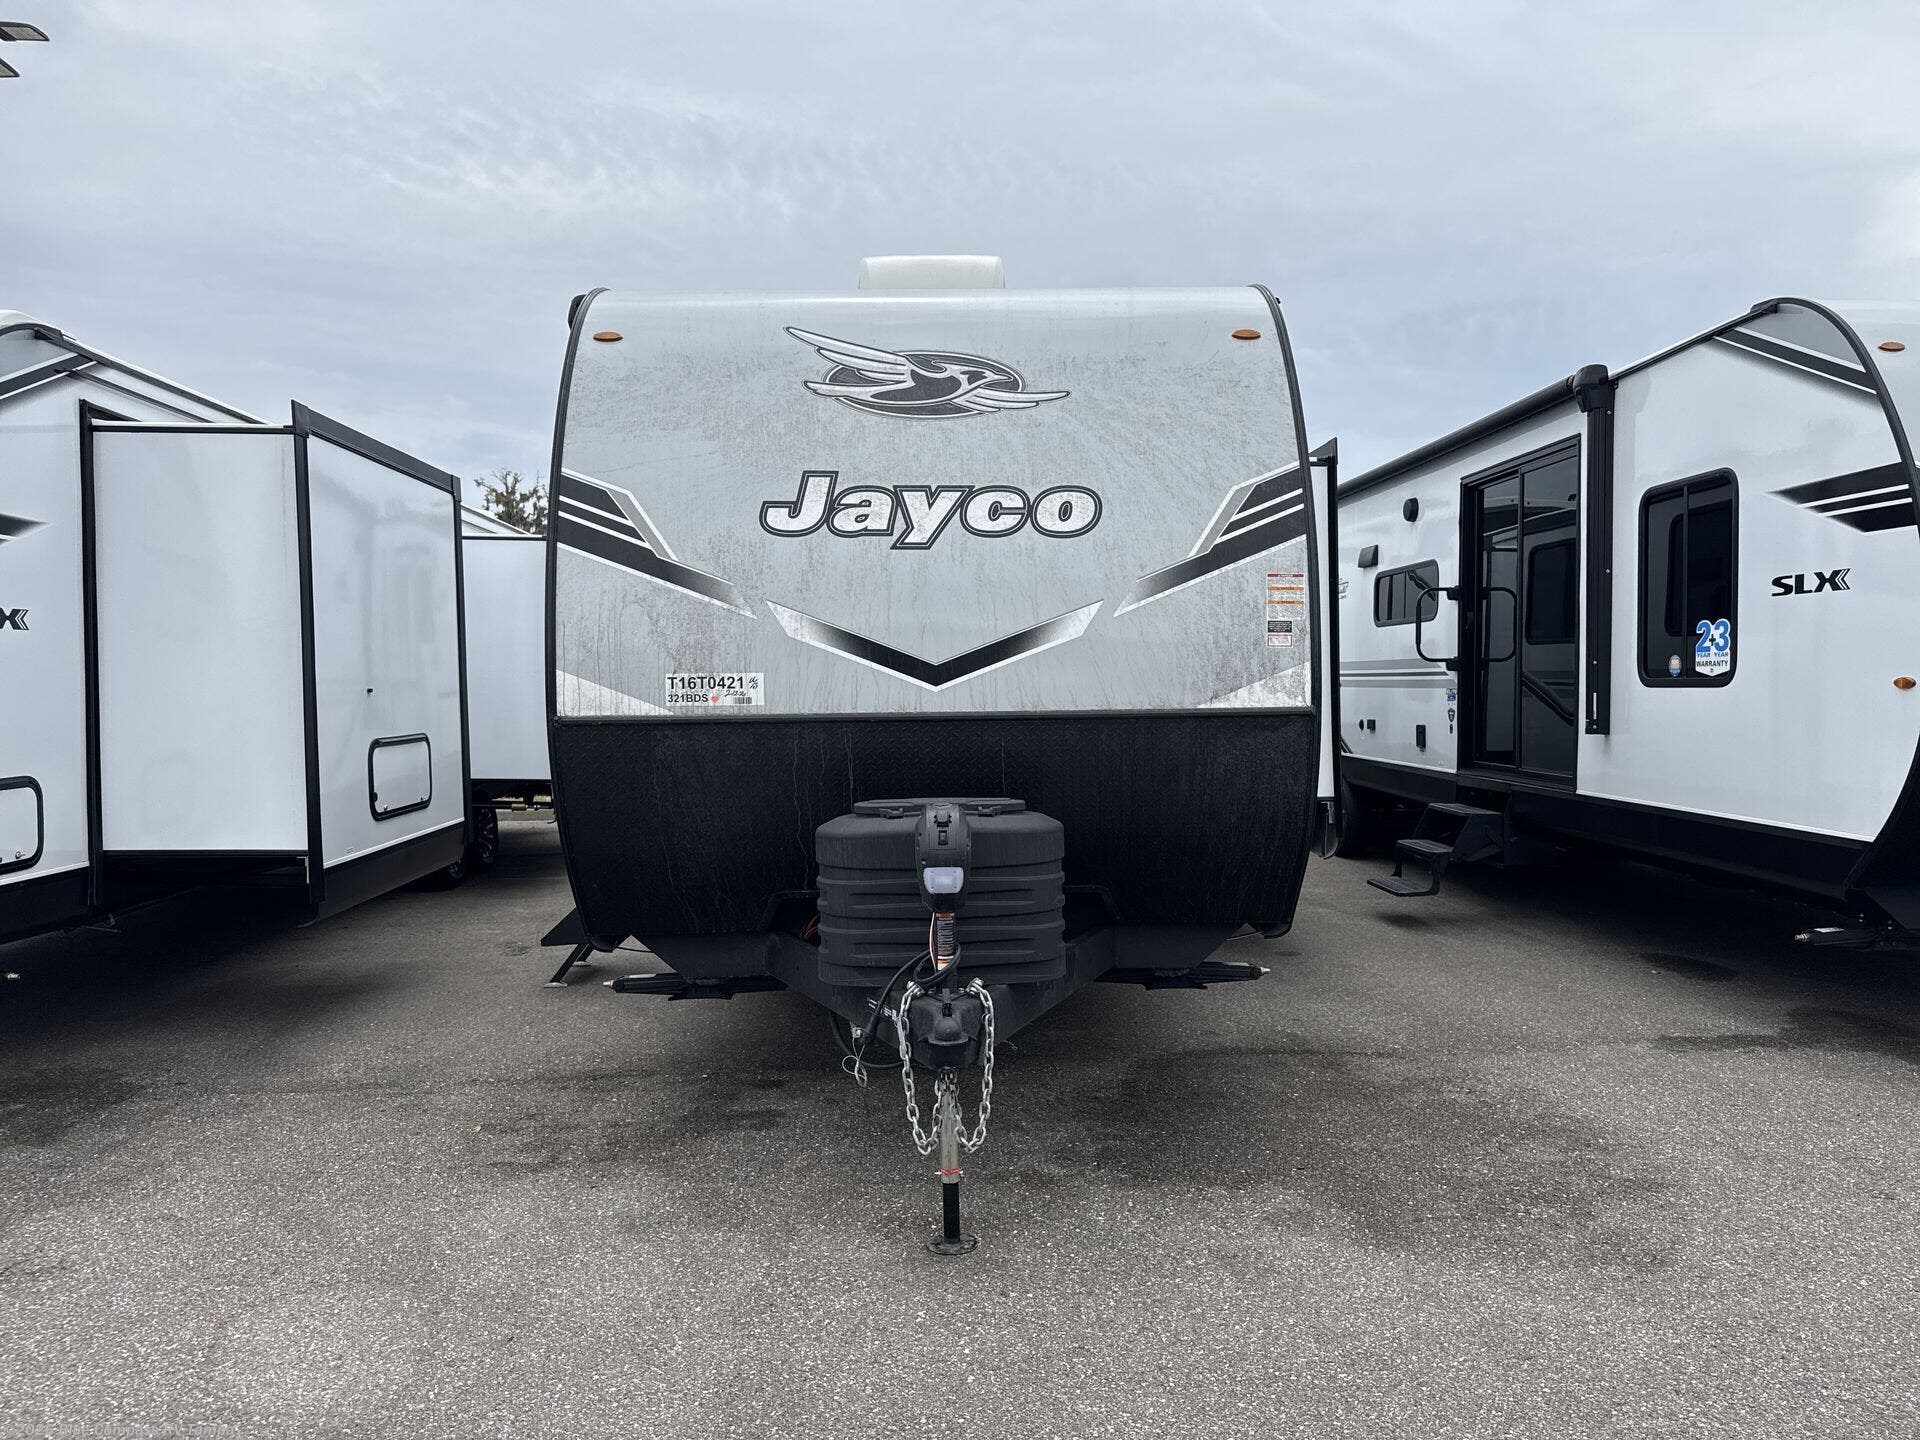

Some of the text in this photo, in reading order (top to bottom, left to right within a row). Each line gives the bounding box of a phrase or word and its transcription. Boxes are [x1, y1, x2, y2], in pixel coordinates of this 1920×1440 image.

[759, 470, 1103, 550] Jayco
[1771, 568, 1851, 597] SLX
[1696, 660, 1729, 668] WARRANTY
[667, 676, 743, 690] T16T0421
[667, 694, 709, 703] 321BDS
